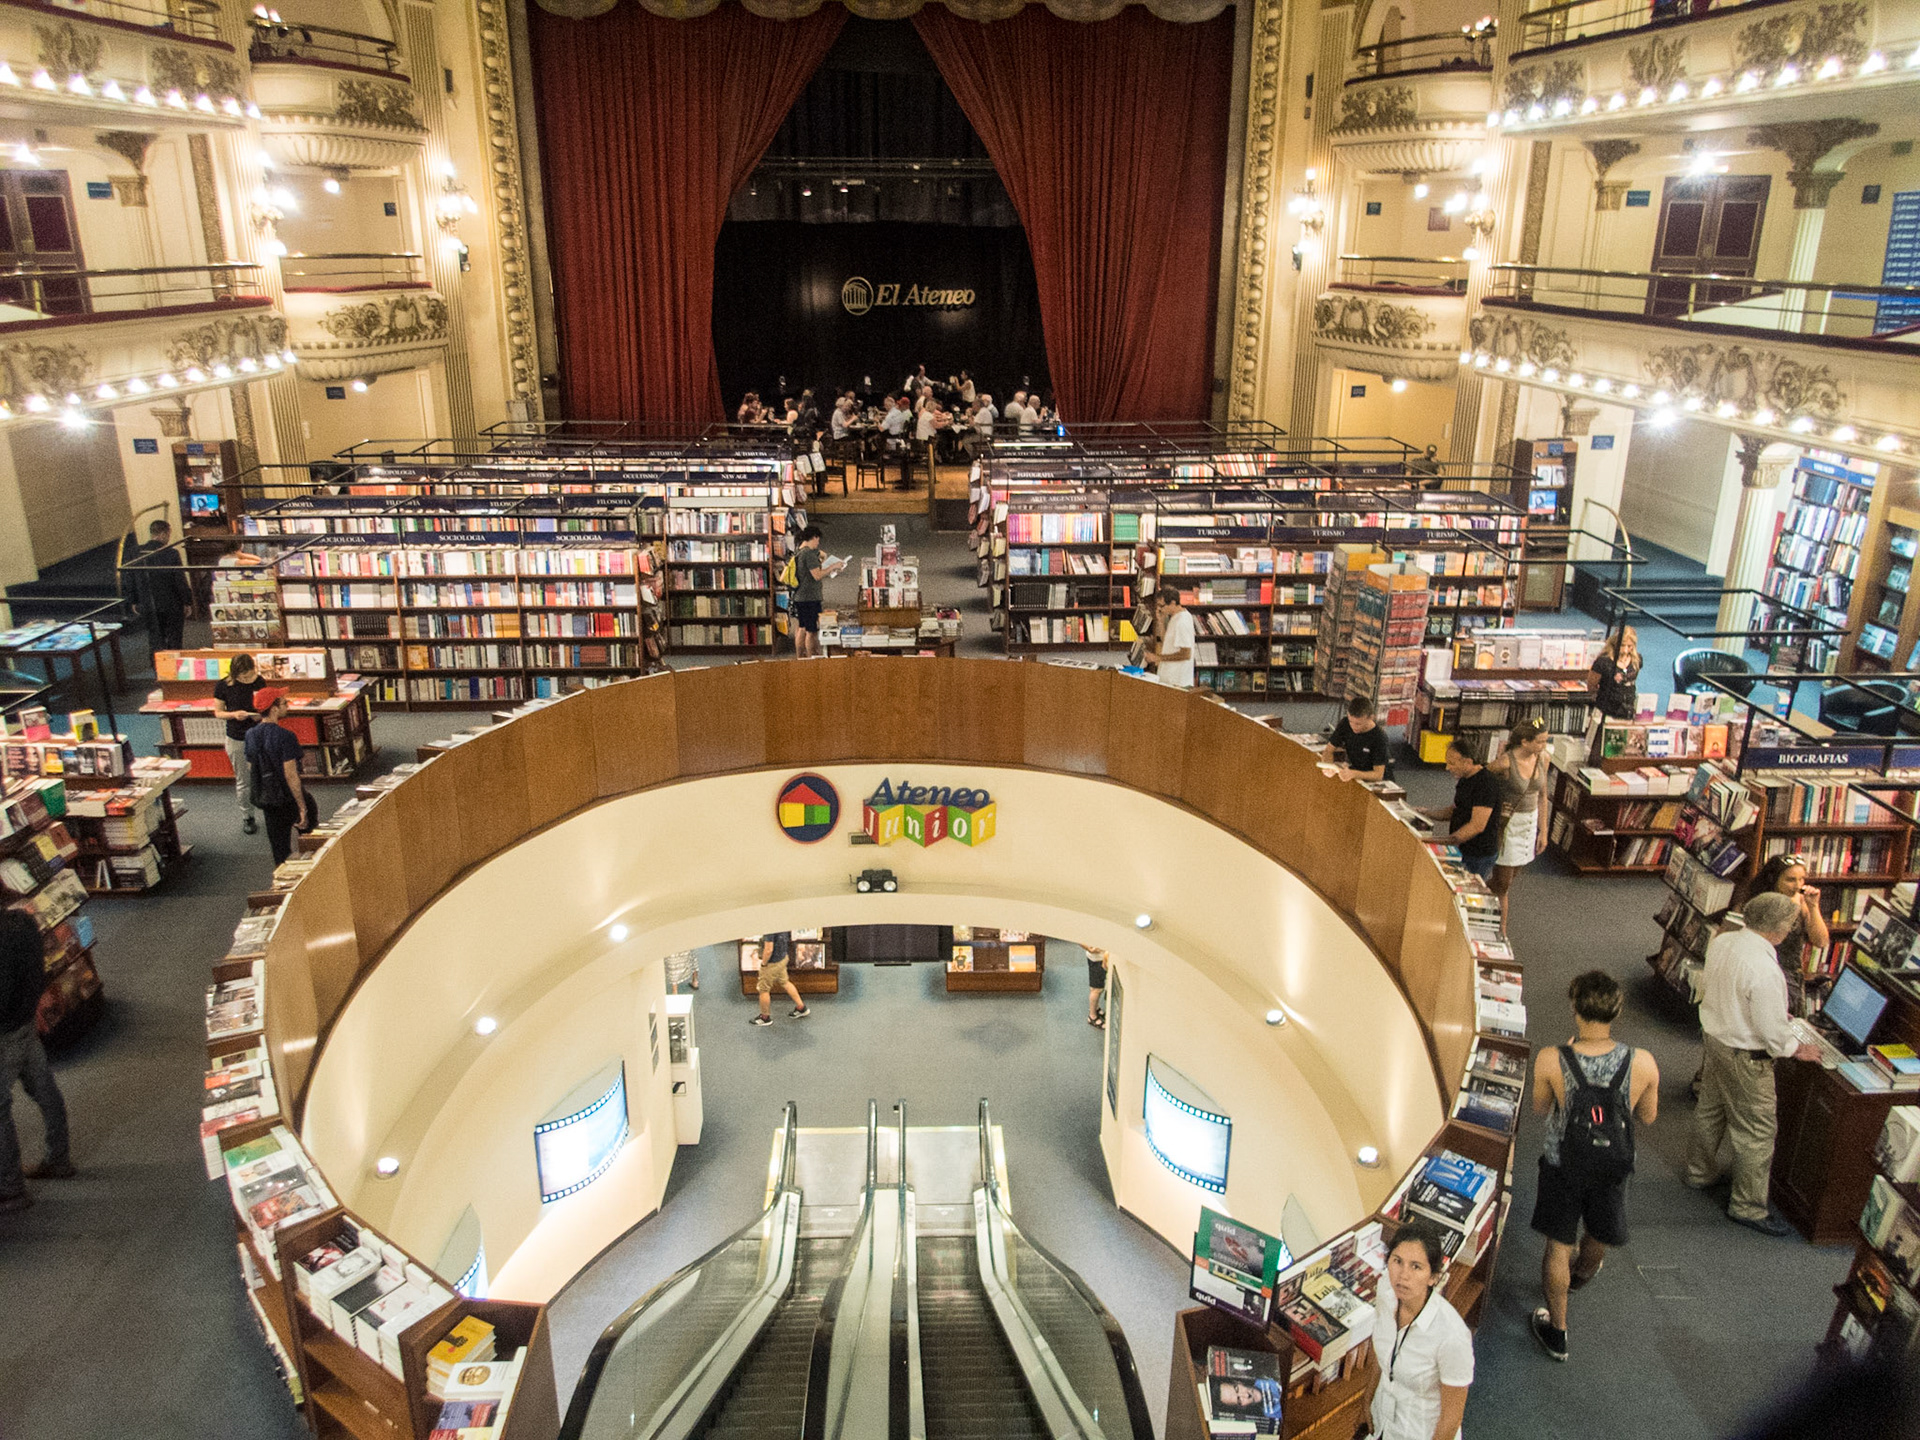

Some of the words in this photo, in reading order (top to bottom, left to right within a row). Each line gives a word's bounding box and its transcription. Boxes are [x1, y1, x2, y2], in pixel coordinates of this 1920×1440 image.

[874, 283, 901, 306] El
[902, 283, 976, 306] Ateneo
[1197, 528, 1230, 536] TURISMO
[1778, 753, 1849, 764] BIOGRAFIAS
[870, 776, 990, 808] Ateneo
[864, 809, 994, 840] Junior
[1214, 1222, 1236, 1236] quid
[1195, 1291, 1217, 1306] quid
[1313, 1285, 1337, 1301] Lula
